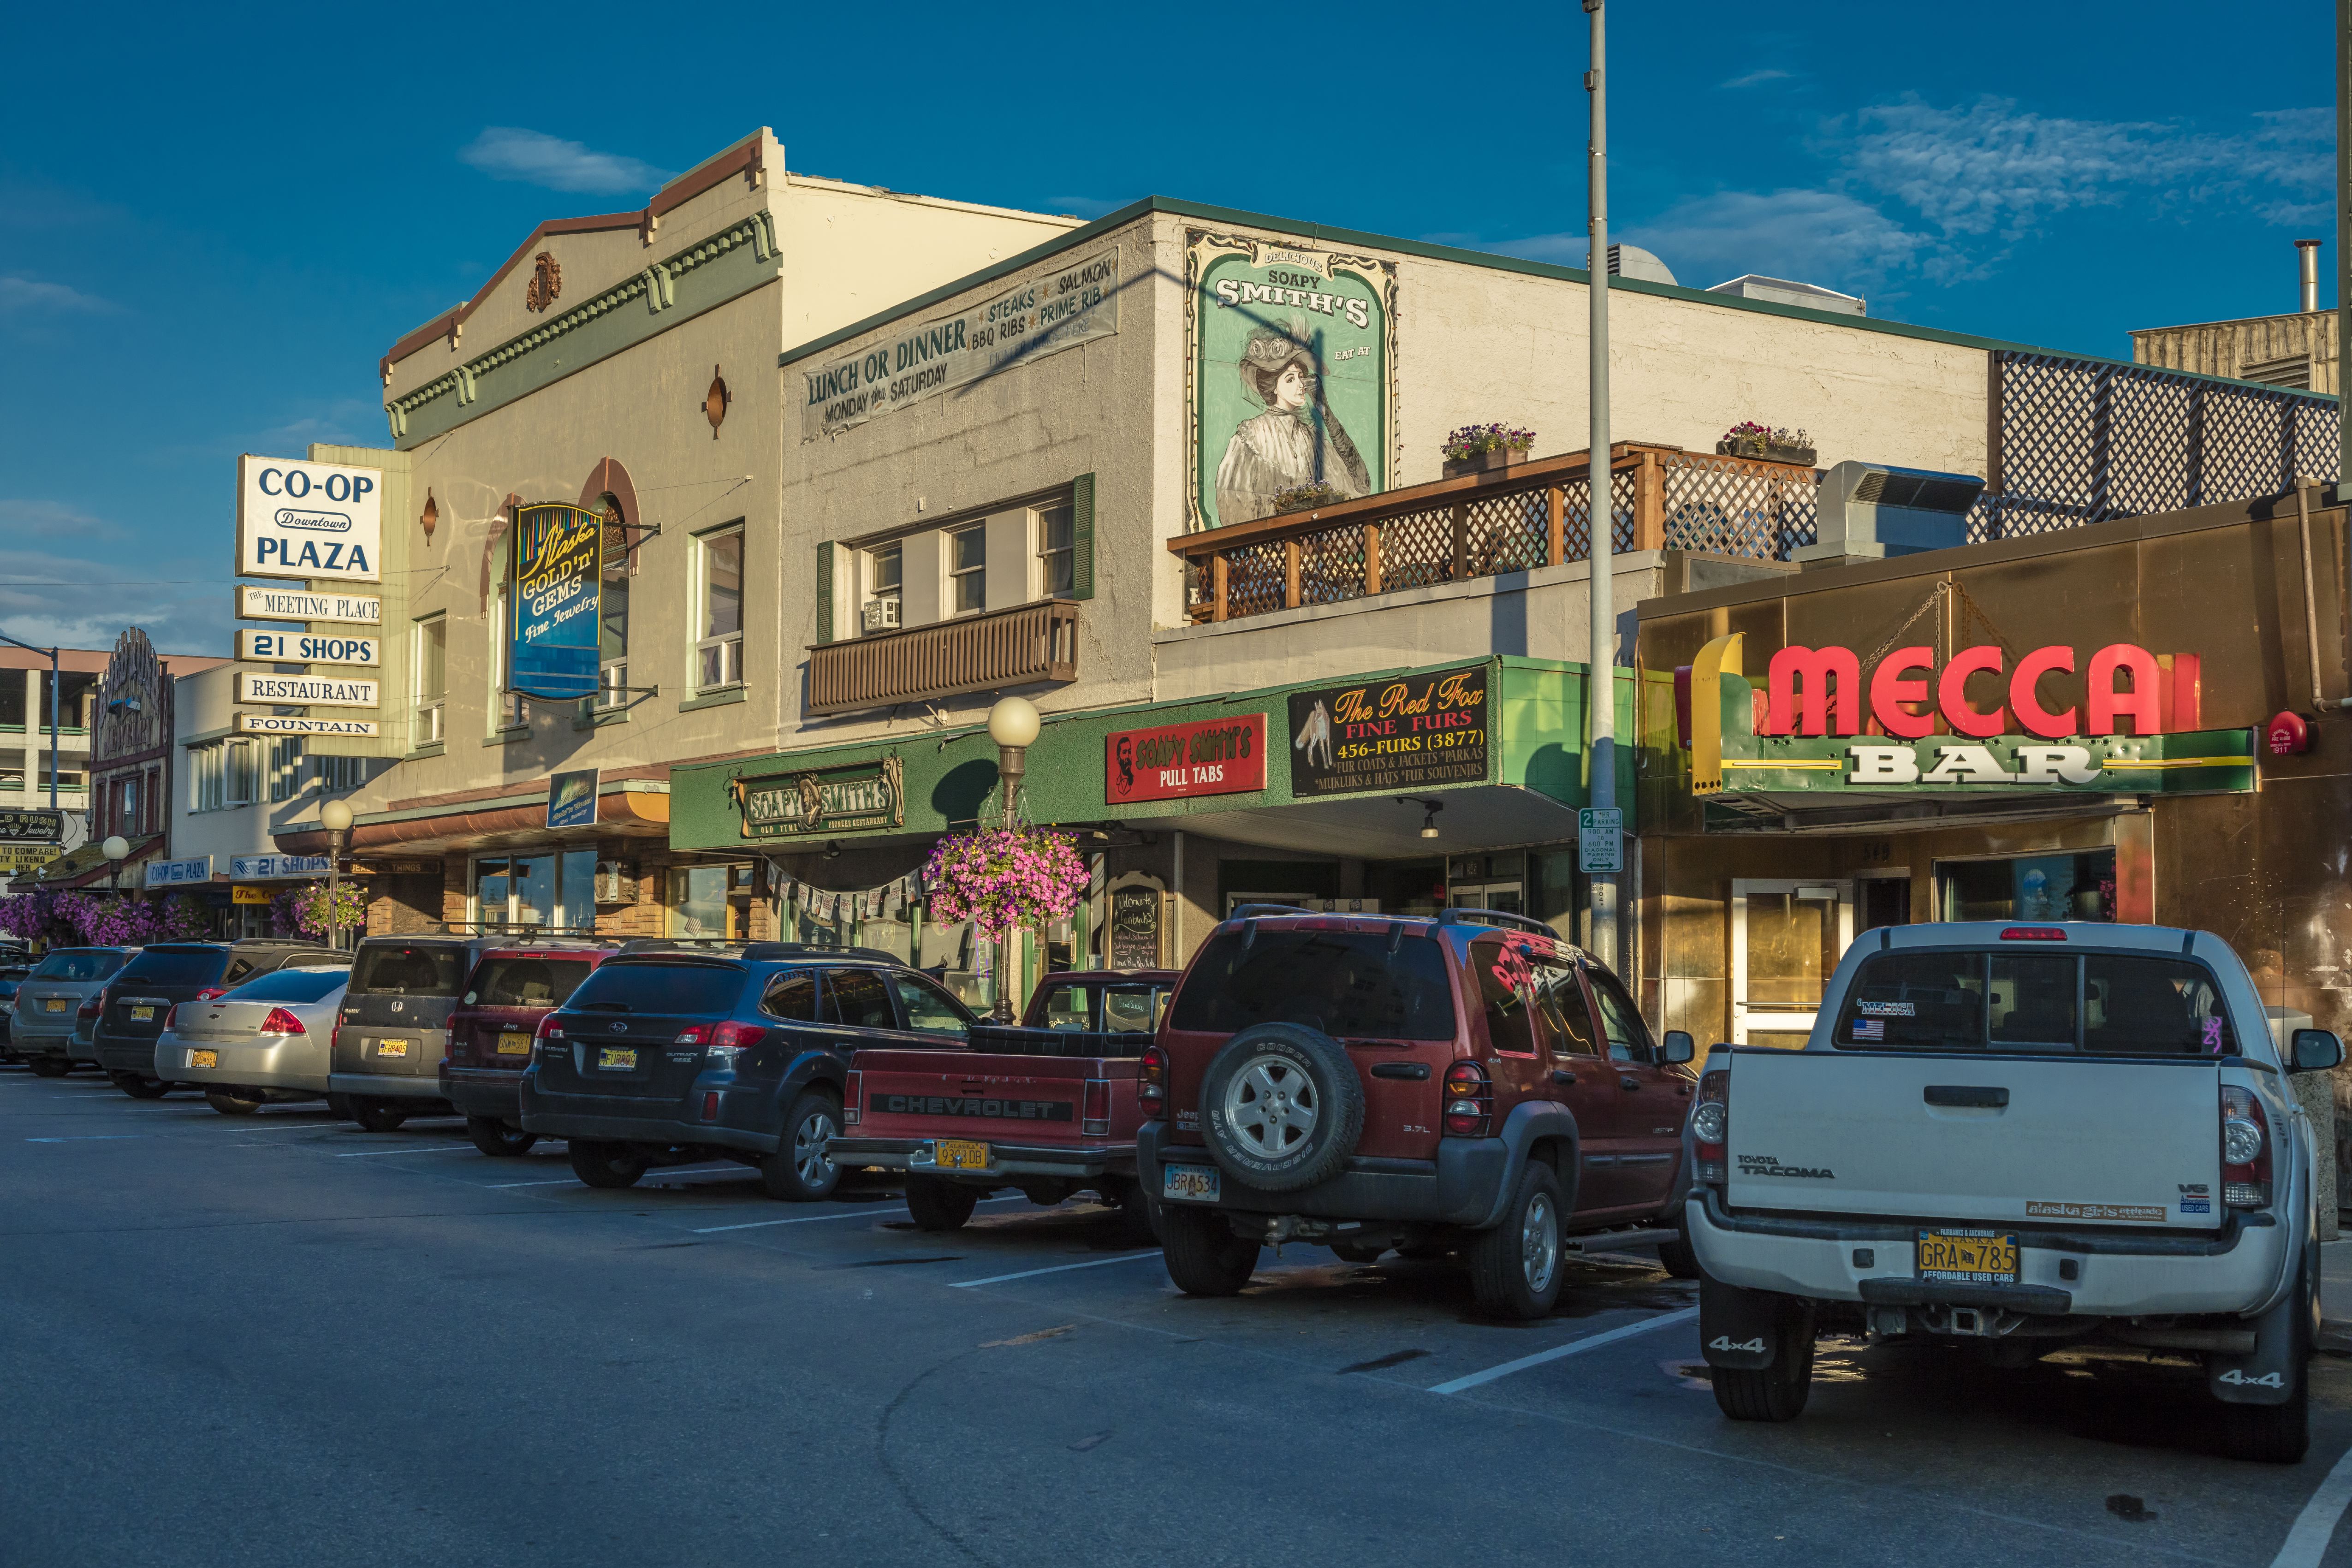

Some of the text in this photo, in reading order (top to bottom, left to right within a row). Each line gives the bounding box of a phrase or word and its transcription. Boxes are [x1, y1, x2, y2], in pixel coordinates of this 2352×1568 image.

[1265, 251, 1323, 273] DELICIOUS
[1269, 270, 1320, 289] SOAPY
[988, 258, 1111, 323] STEAKS SALMON
[1216, 279, 1369, 329] SMITH'S
[972, 286, 1101, 350] BBQ RIBS PRIME RIB
[808, 318, 967, 406] LUNCH OR DINNER
[1335, 346, 1371, 361] EAT AT
[824, 362, 948, 424] MONDAY thru SATURDAY
[259, 468, 374, 503] CO-OP
[281, 511, 347, 529] Downtown
[257, 536, 369, 572] PLAZA
[519, 521, 599, 580] Alaska
[523, 565, 573, 600] GOLD
[248, 590, 380, 619] THE MEETING PLACE
[532, 574, 582, 617] GEMS
[525, 594, 599, 644] Fine Jewelry
[255, 635, 371, 662] 21 SHOPS
[252, 679, 371, 701] RESTAURANT
[1334, 673, 1484, 724] The Red Fox
[1769, 643, 2161, 738] MECCA
[249, 718, 370, 734] FOUNTAIN
[1345, 710, 1472, 739] FINE FURS
[103, 716, 153, 756] JEWELRY
[1337, 729, 1484, 759] 456-FURS (3877)
[1136, 726, 1252, 770] SOAPY SMITH'S
[1358, 757, 1386, 771] COATS
[1389, 757, 1396, 768] &
[1397, 752, 1438, 768] JACKETS
[1850, 745, 2104, 785] BAR
[1160, 765, 1223, 787] PULL TABS
[1366, 775, 1372, 785] &
[1375, 771, 1398, 785] HATS
[1427, 762, 1482, 779] SOUVENIRS
[751, 788, 801, 819] SOAPY
[20, 814, 56, 827] RUSH
[761, 816, 888, 834] OLD TYME PIONEER RESTAURANT
[1583, 813, 1591, 826] 2
[20, 824, 55, 837] Jewelry
[152, 866, 169, 882] CO-OP
[186, 862, 204, 878] PLAZA
[258, 857, 328, 874] 21 SHOPS
[393, 863, 421, 872] THINGS
[235, 890, 256, 899] The
[823, 896, 834, 904] LIGHT
[891, 889, 900, 898] FIRST
[1117, 892, 1151, 909] Welcome to
[823, 903, 832, 911] BEER
[1121, 910, 1152, 924] Fairbanks
[384, 1044, 406, 1053] FHP405
[499, 1039, 528, 1049] GNW 551
[206, 1055, 215, 1064] 664
[606, 1053, 636, 1067] FUR899
[1257, 1043, 1312, 1068] COOPER
[888, 1096, 1054, 1119] CHEVROLET
[1403, 1124, 1430, 1134] 3.7L
[1738, 1154, 1780, 1165] TOYOTA
[1738, 1164, 1835, 1179] TACOMA
[1167, 1173, 1217, 1194] JBR 534
[2178, 1183, 2209, 1194] V6
[2180, 1195, 2210, 1204] Affordable
[2028, 1203, 2080, 1216] alaska
[2082, 1206, 2118, 1218] girls
[1942, 1236, 1996, 1245] ALASKA
[1921, 1242, 2015, 1271] GRA 785
[1923, 1271, 2014, 1283] AFFORDABLE USED CARS
[1709, 1336, 1767, 1353] 4x4
[2219, 1369, 2285, 1389] 4x4
